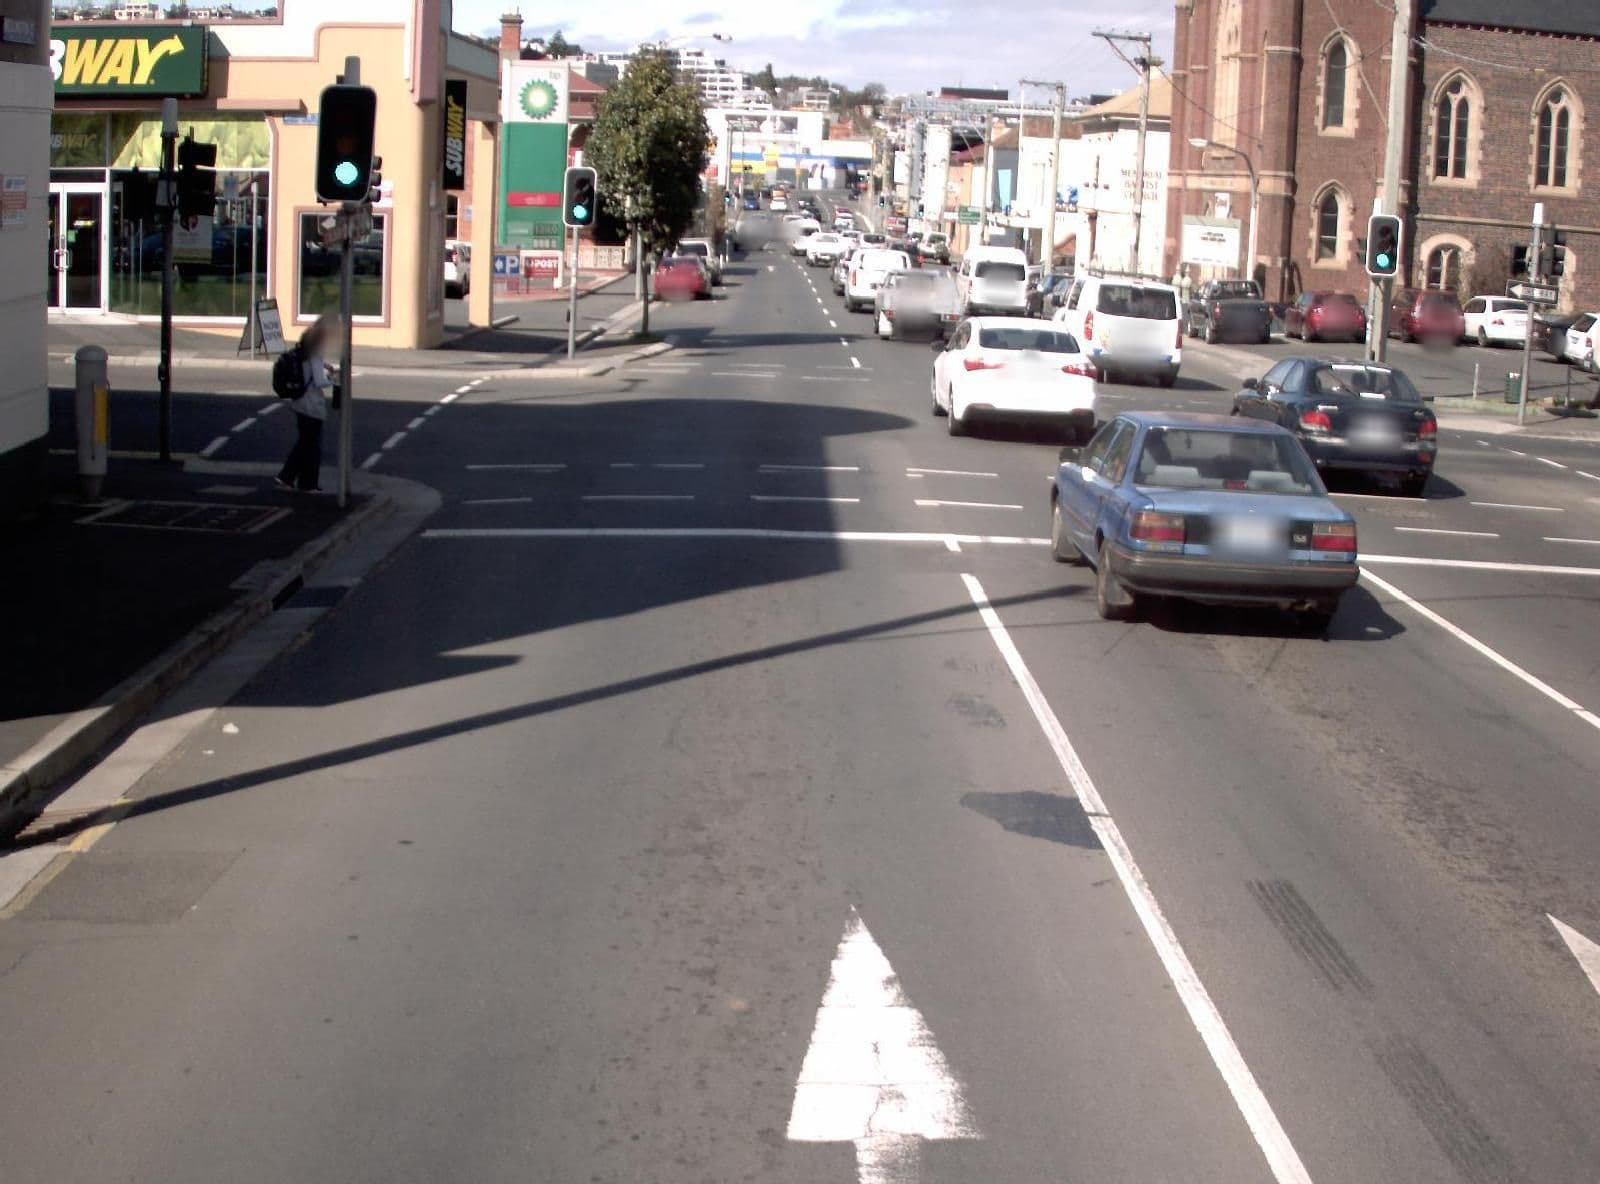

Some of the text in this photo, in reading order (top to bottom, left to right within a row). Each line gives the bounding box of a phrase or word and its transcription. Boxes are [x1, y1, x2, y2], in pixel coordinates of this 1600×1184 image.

[445, 95, 465, 176] SUBWAY
[506, 255, 520, 273] P
[534, 258, 559, 269] POST
